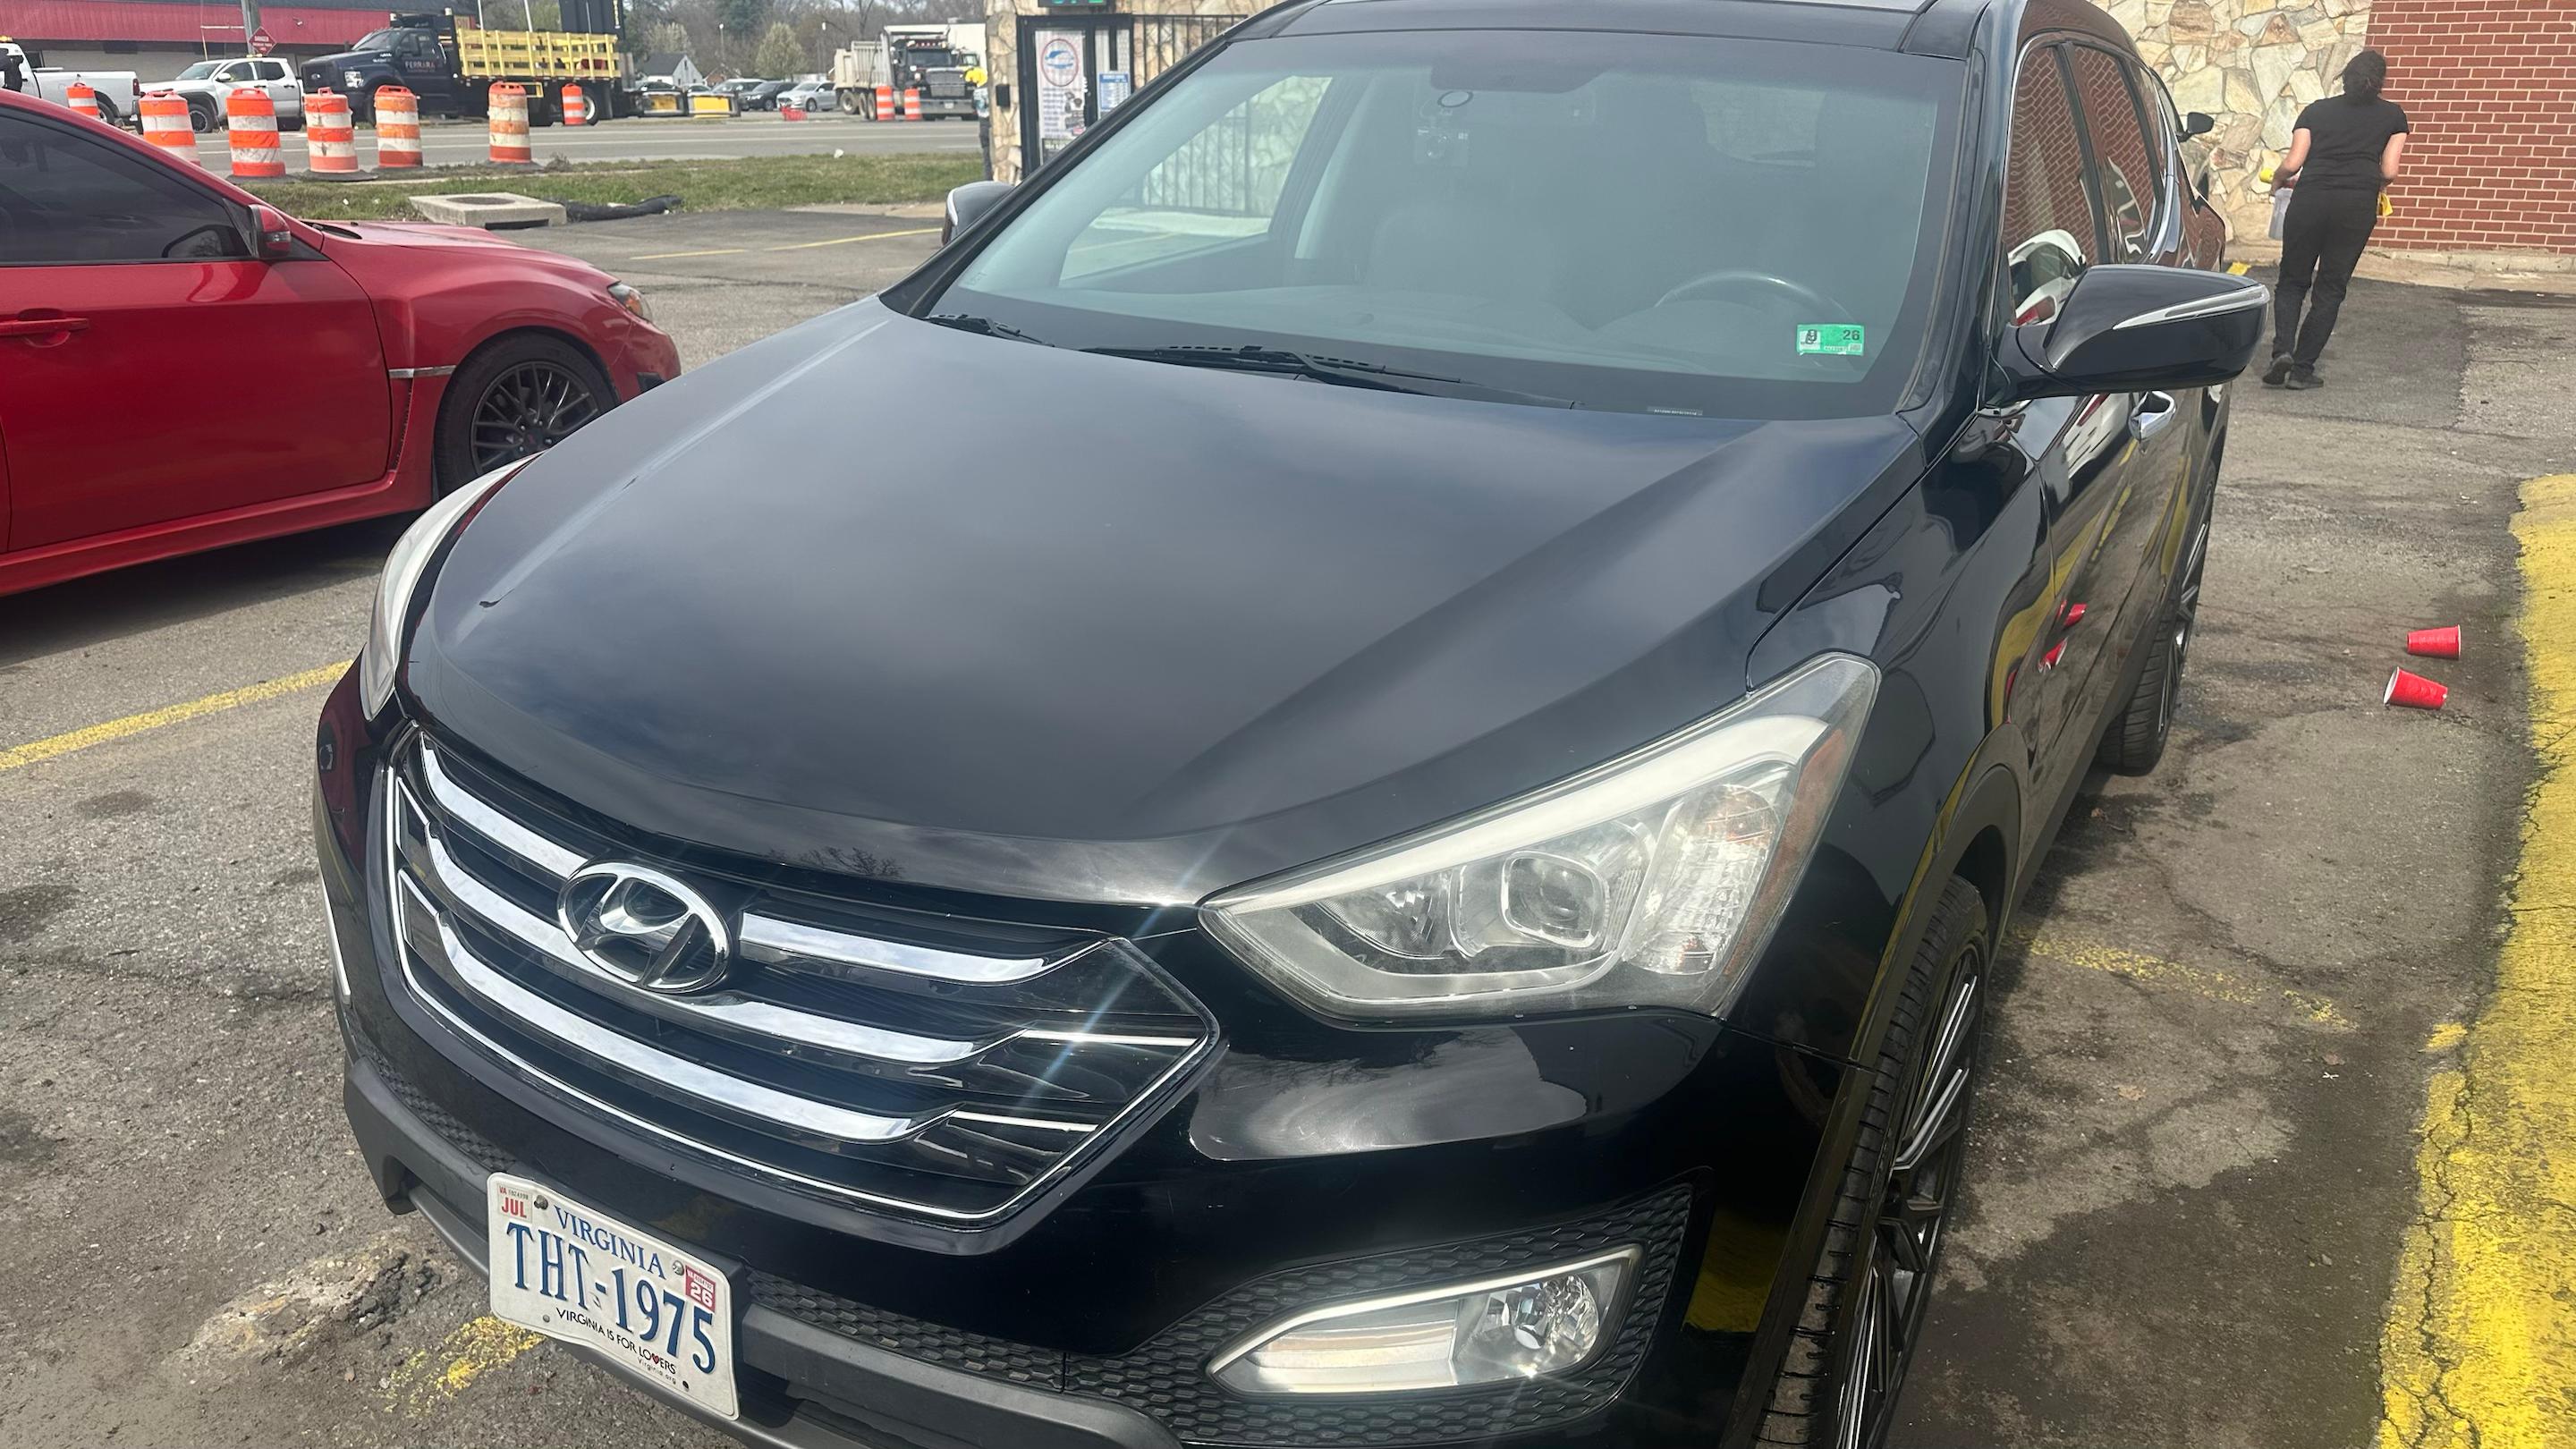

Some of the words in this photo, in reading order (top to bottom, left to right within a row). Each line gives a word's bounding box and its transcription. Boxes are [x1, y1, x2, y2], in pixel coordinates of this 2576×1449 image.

[1843, 330, 1860, 341] 26
[501, 1197, 527, 1218] JUL
[554, 1205, 666, 1280] VIRGINIA
[506, 1222, 716, 1375] THT-1975
[690, 1281, 713, 1308] 26
[555, 1307, 606, 1336] VIRGINIA
[607, 1329, 614, 1342] IS
[616, 1335, 638, 1354] FOR
